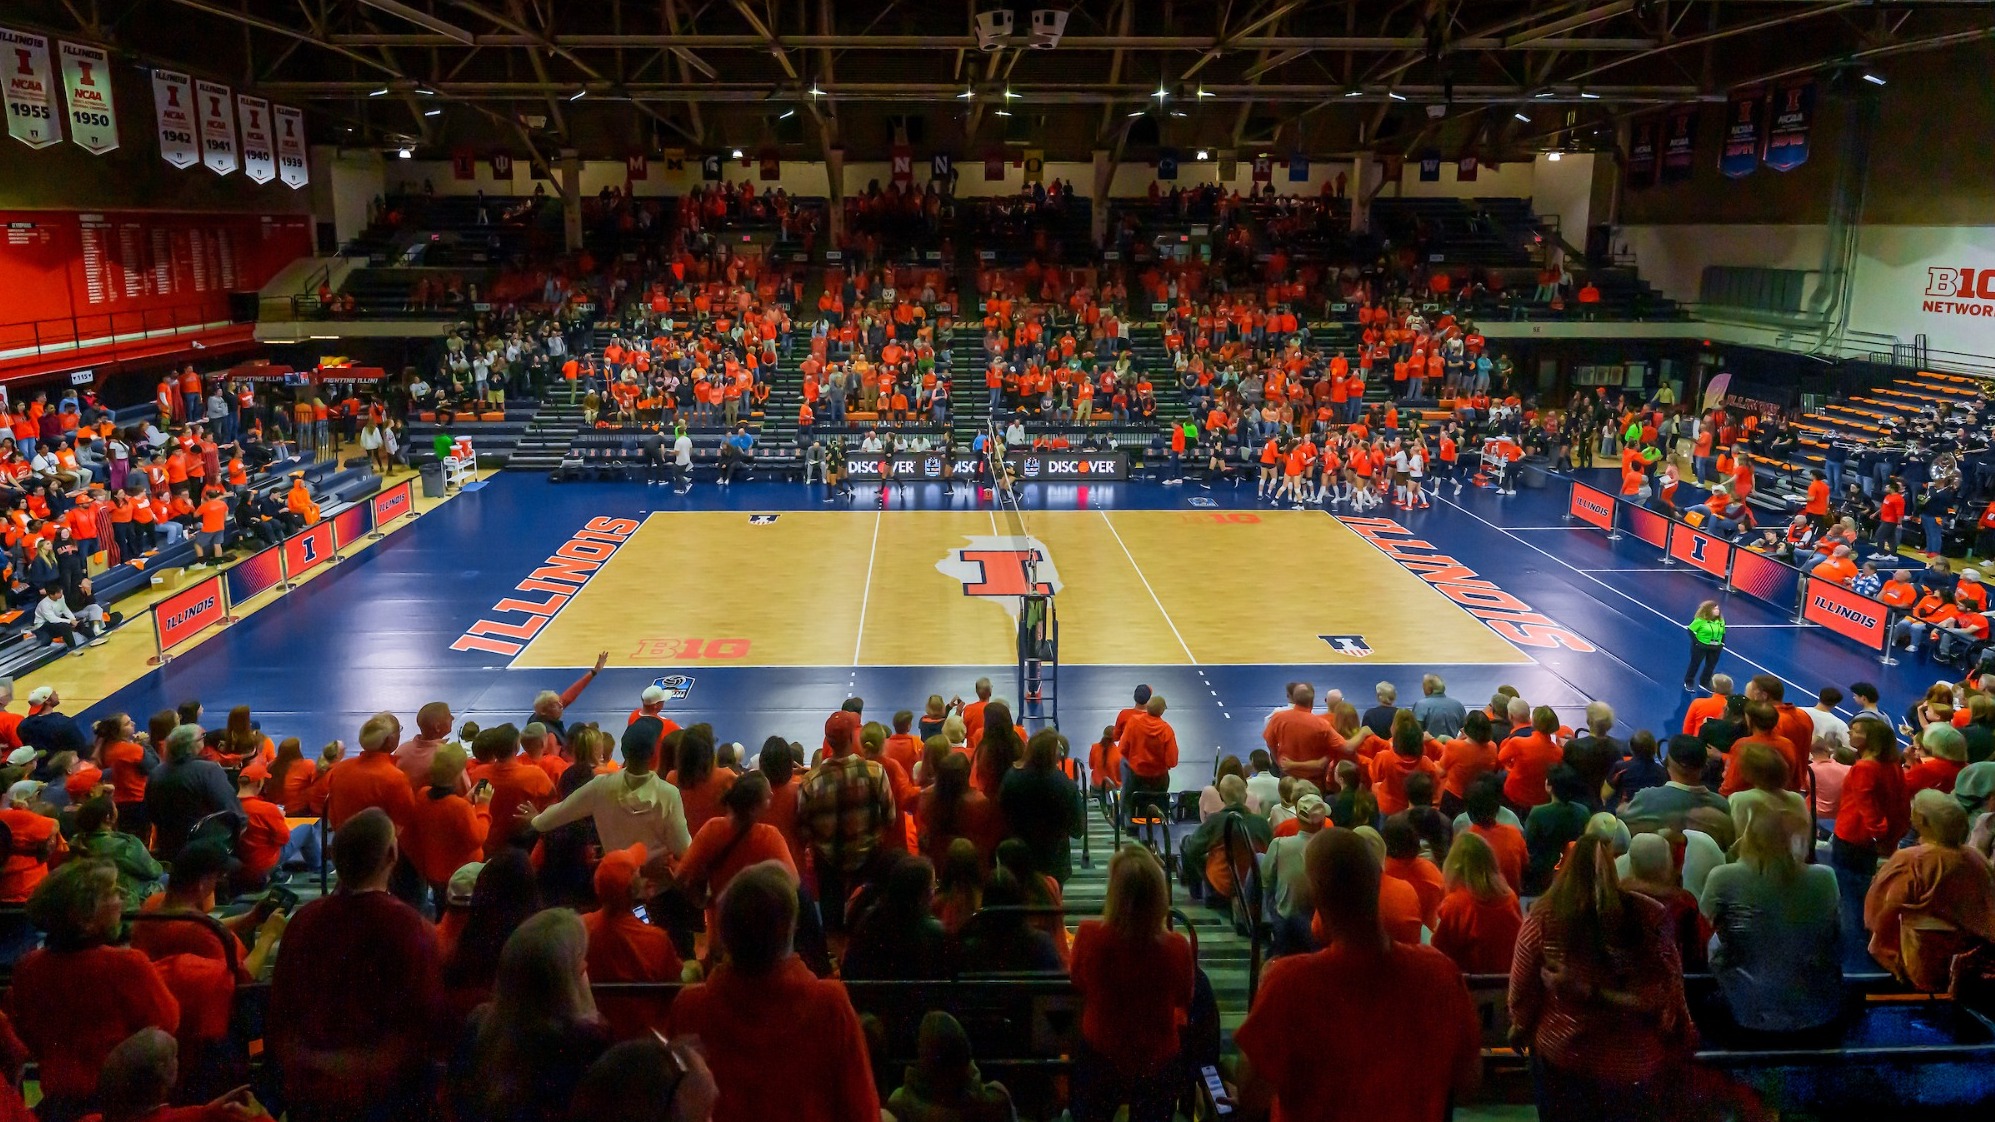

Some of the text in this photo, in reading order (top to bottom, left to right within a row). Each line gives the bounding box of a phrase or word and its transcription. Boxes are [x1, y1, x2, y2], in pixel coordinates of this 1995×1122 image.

[63, 45, 104, 60] ILLINOIS
[11, 79, 43, 91] NCAA
[74, 89, 103, 101] NCAA
[10, 103, 51, 119] 1955
[72, 111, 110, 127] 1950
[162, 130, 192, 144] 1942
[206, 139, 231, 152] 1941
[246, 150, 270, 161] 1940
[281, 157, 303, 168] 1939
[894, 156, 911, 173] N
[1923, 301, 1995, 317] NETWOR
[1048, 460, 1114, 473] DISCOVER
[379, 493, 406, 513] ILLINOIS
[1576, 496, 1609, 518] ILLINOIS
[302, 535, 317, 563] I
[1691, 535, 1707, 562] I
[449, 516, 640, 657] ILLINOIS
[1335, 515, 1597, 653] ILLINOIS
[165, 596, 215, 631] ILLINOIS
[1813, 595, 1877, 629] ILLINOIS
